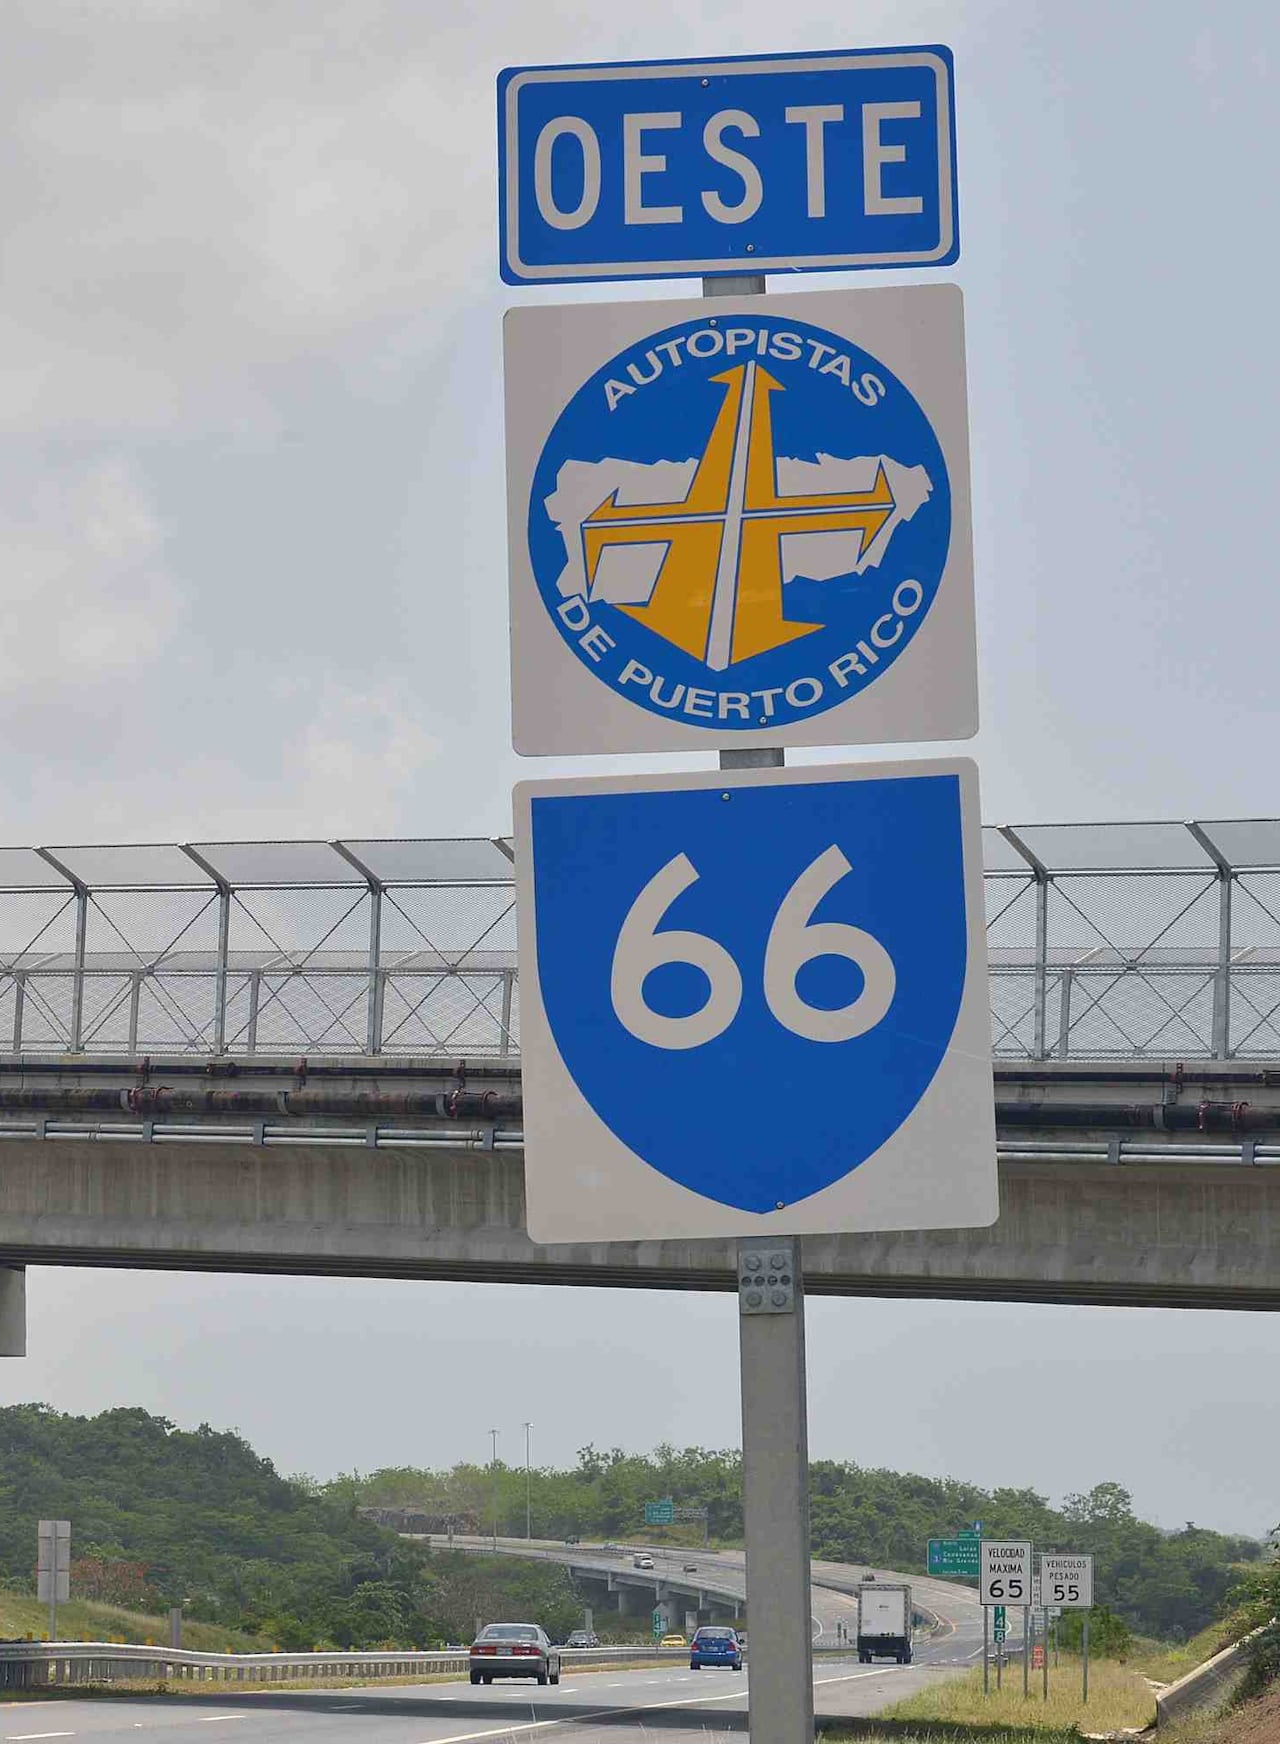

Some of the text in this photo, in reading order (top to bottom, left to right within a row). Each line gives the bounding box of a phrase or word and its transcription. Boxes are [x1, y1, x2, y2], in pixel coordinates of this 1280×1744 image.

[533, 100, 924, 231] OESTE
[602, 327, 887, 412] AUTOPISTAS
[556, 578, 924, 720] DE PUERTO RICO
[610, 843, 897, 1051] 66
[987, 1547, 1025, 1559] VELOCIDAD
[989, 1563, 1023, 1574] MAXIMA
[1046, 1560, 1087, 1569] VEHICULOS
[1049, 1572, 1080, 1581] PESADO
[989, 1579, 1023, 1599] 65
[1053, 1584, 1080, 1602] 55
